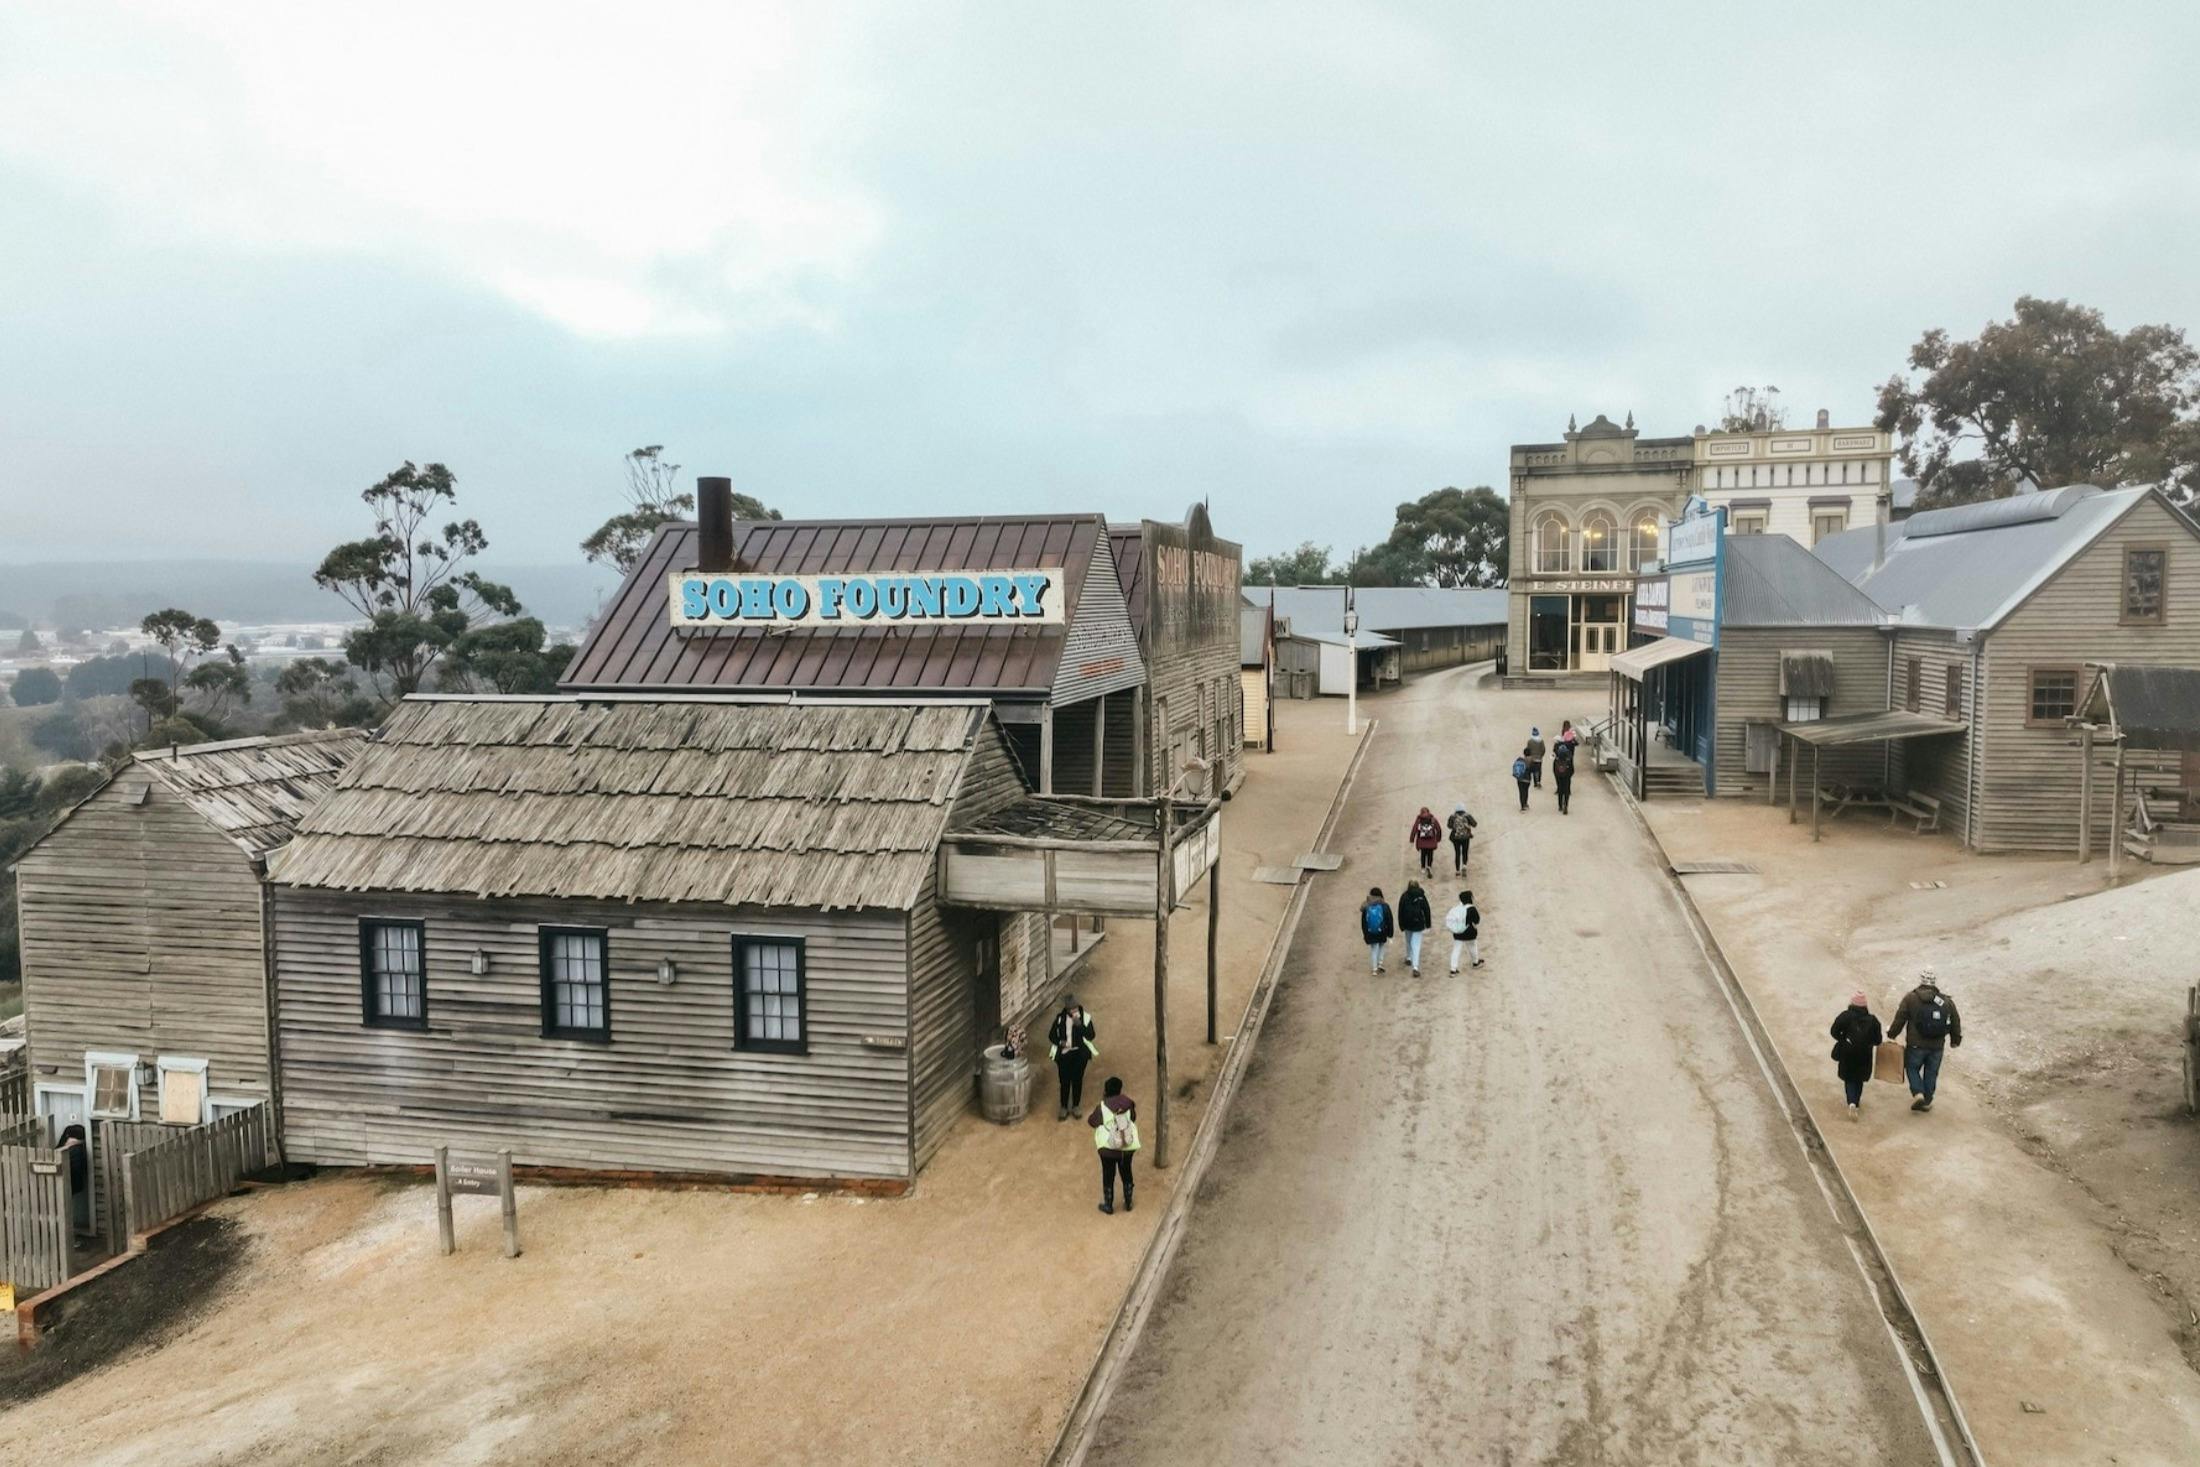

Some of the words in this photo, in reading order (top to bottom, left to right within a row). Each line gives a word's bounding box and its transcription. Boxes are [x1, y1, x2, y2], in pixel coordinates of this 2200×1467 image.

[1157, 544, 1189, 584] SOHO
[1193, 550, 1238, 586] FOUNDRY
[682, 577, 811, 620] SOHO
[818, 575, 1052, 619] FOUNDRY
